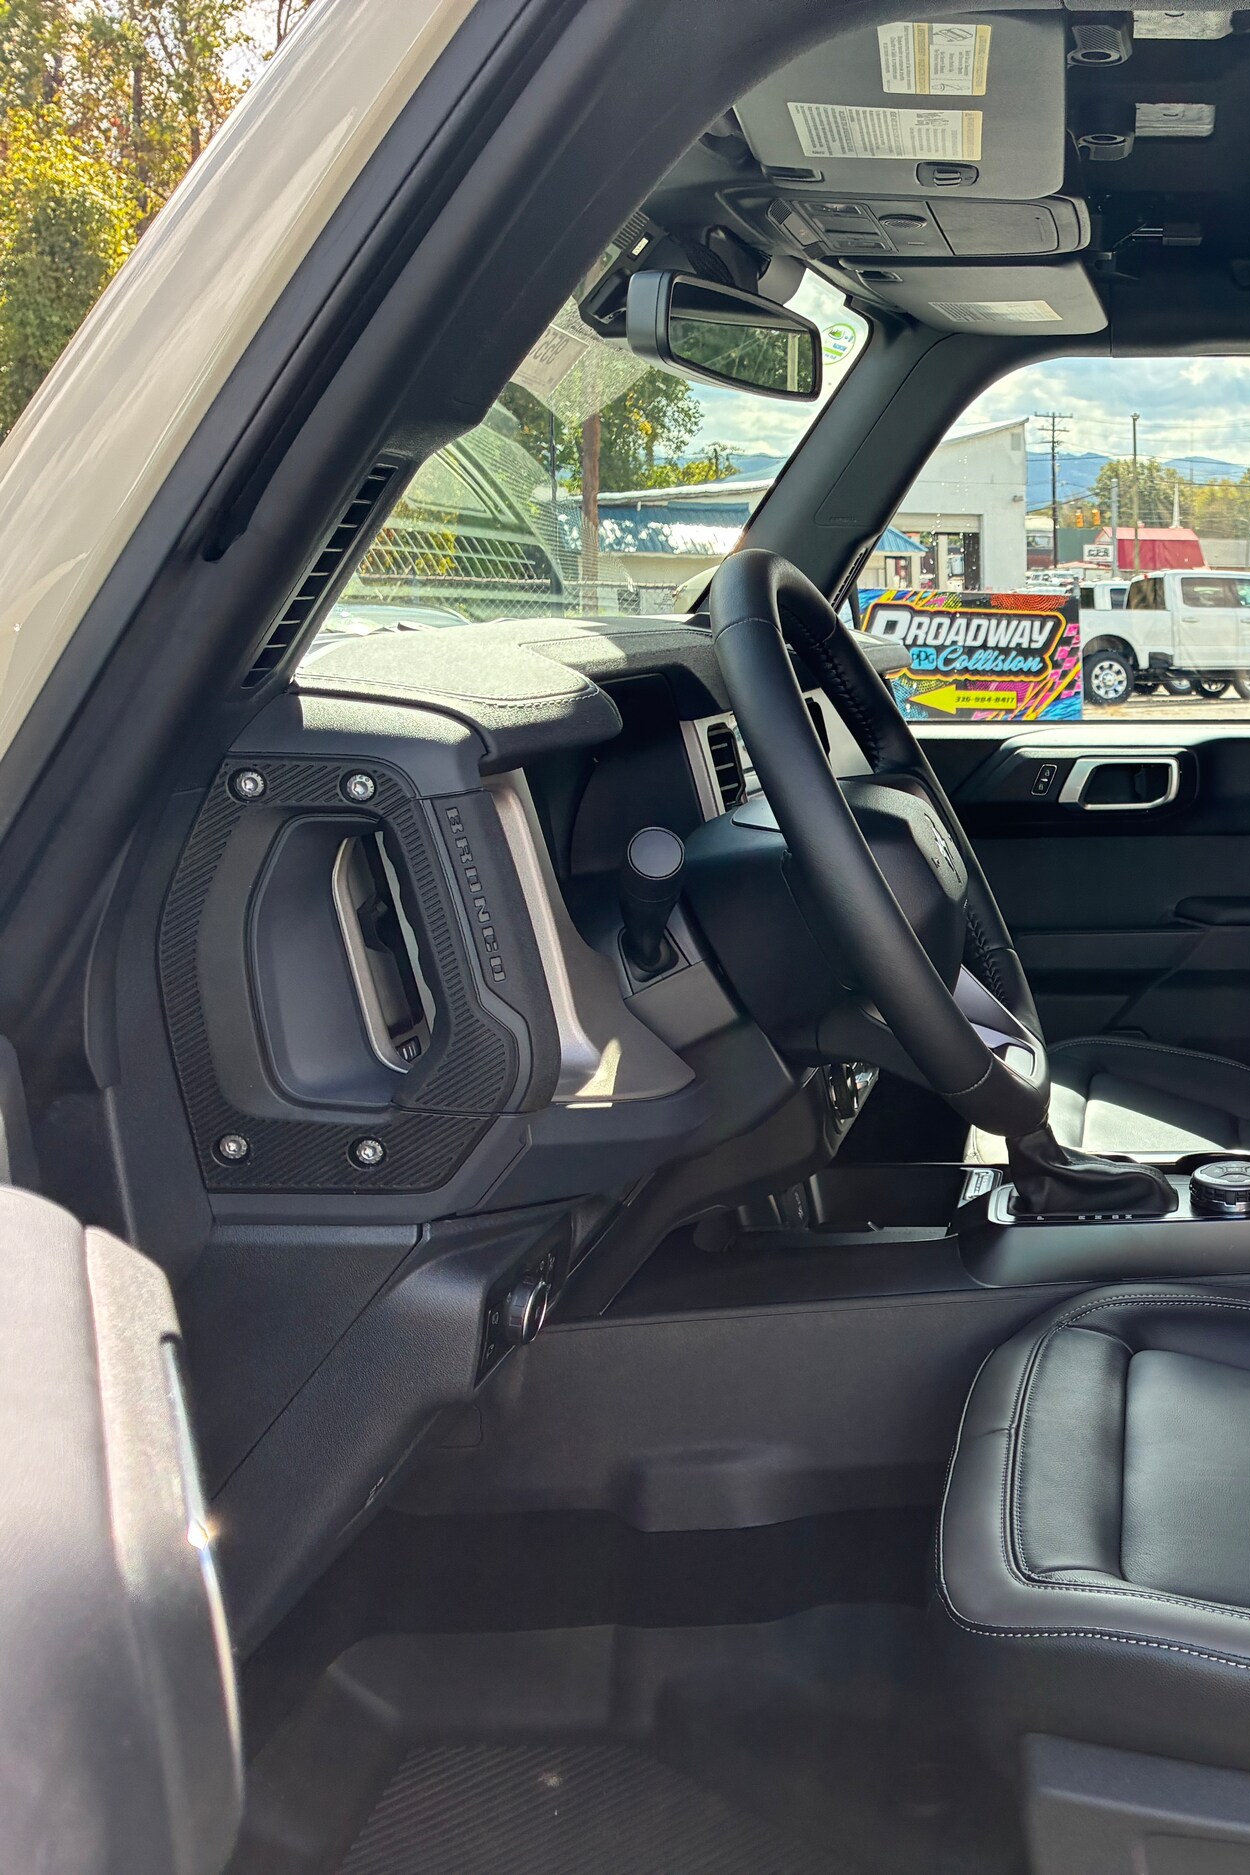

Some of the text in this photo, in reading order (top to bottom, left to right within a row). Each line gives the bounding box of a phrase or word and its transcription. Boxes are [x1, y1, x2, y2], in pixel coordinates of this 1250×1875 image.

[871, 610, 1055, 649] BROADWAY
[937, 646, 1044, 673] Collision
[446, 806, 508, 983] BRONCO
